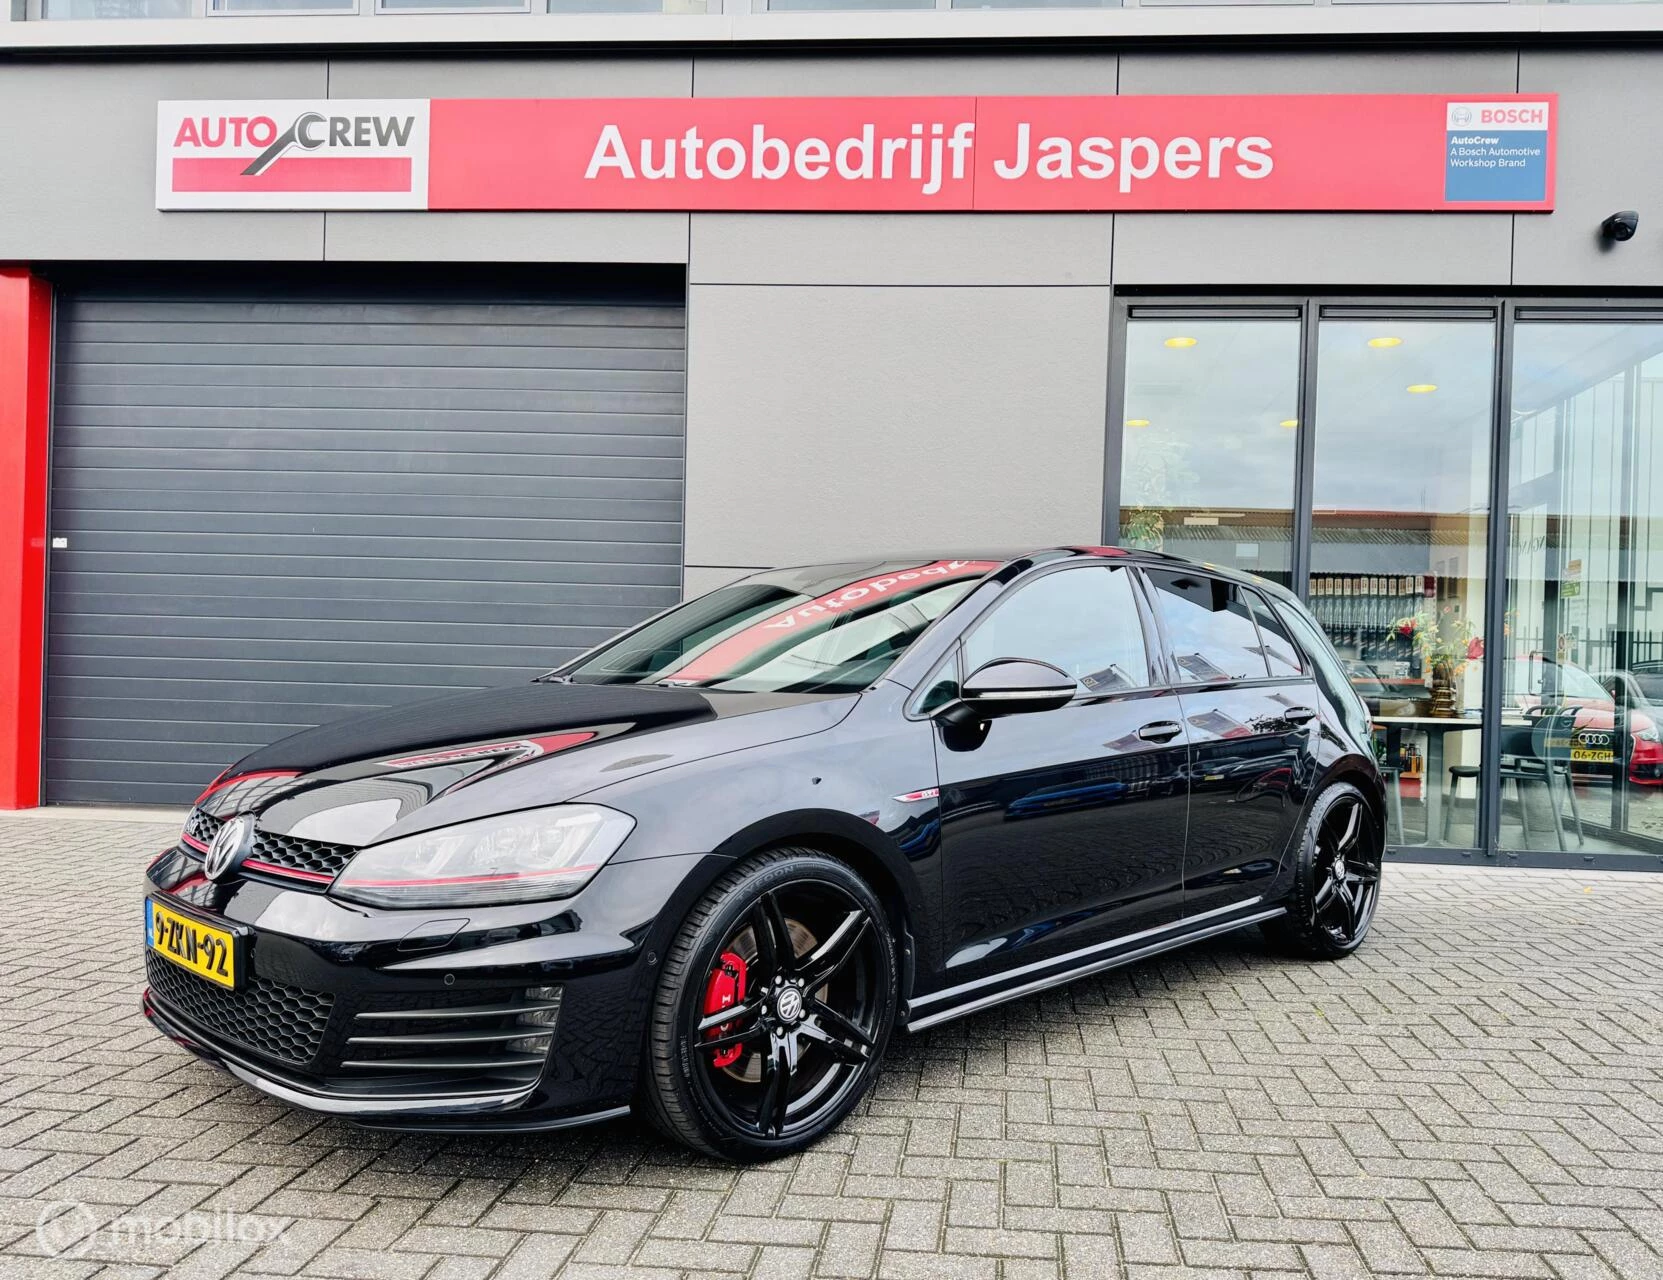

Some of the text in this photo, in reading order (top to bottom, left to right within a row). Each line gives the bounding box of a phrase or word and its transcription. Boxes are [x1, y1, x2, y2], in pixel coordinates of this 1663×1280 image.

[1481, 109, 1543, 124] BOSCH
[173, 112, 415, 149] AUTO CREW
[1450, 136, 1500, 145] AutoCrew
[583, 122, 1275, 196] Autobedrijf Jaspers
[1450, 147, 1541, 156] A Bosch Automotive
[1450, 158, 1526, 168] Workshop Brand
[155, 911, 229, 978] 9-ZKN-92
